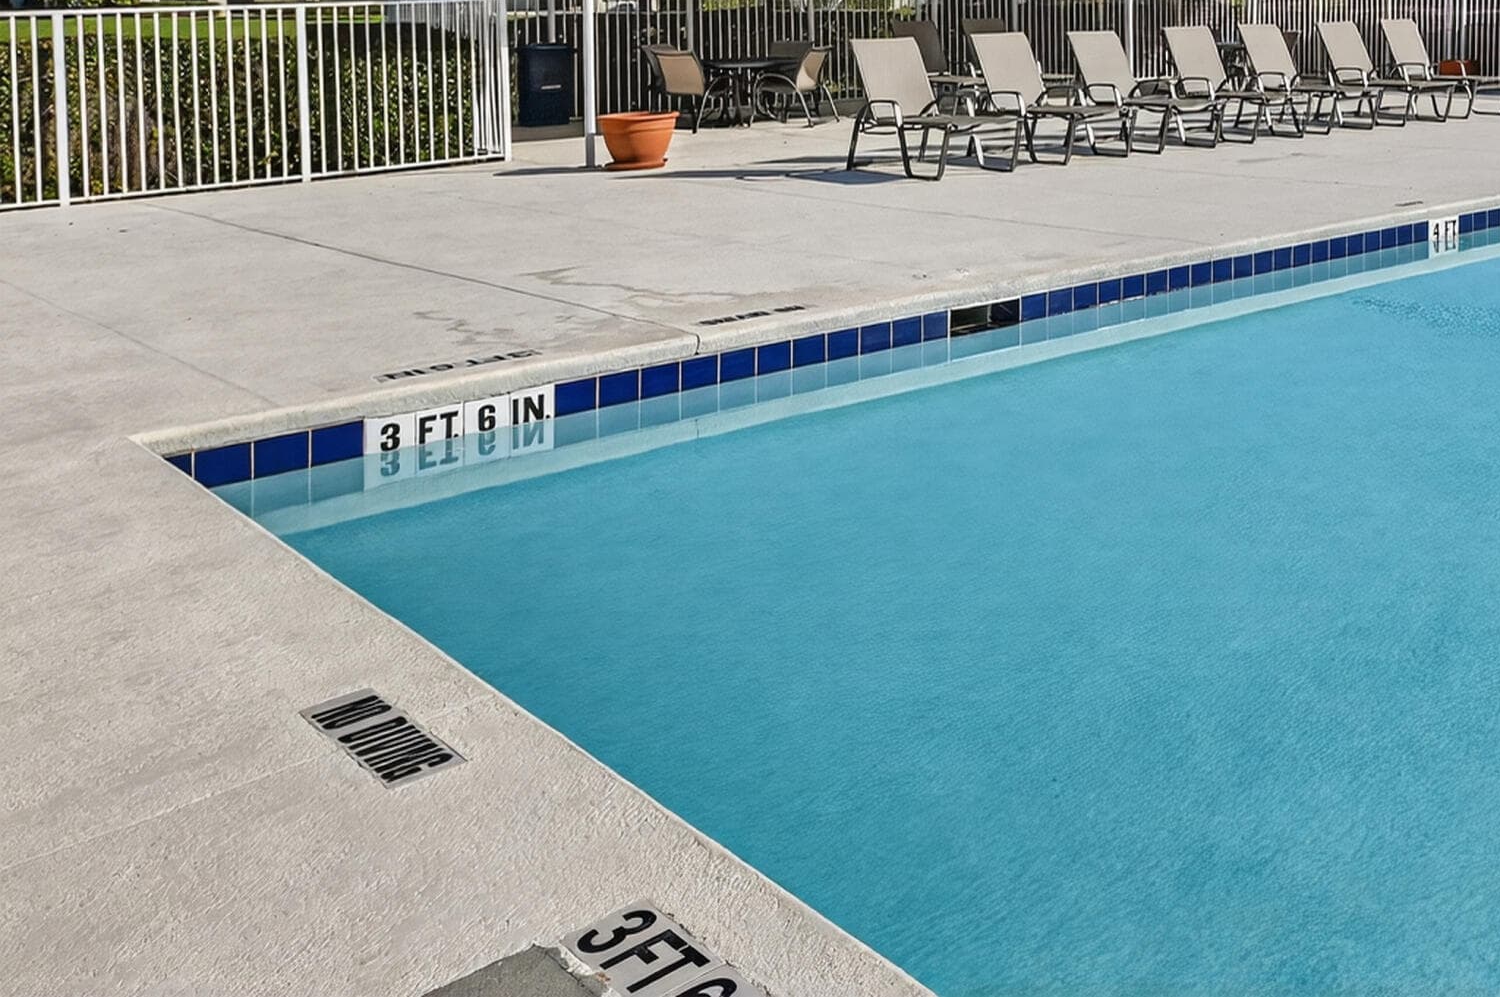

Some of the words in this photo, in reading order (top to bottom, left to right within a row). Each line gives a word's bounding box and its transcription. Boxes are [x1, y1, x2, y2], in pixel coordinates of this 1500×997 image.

[380, 423, 400, 452] 3
[478, 405, 496, 433] 6
[311, 695, 392, 730] NO
[337, 716, 454, 784] DIVING
